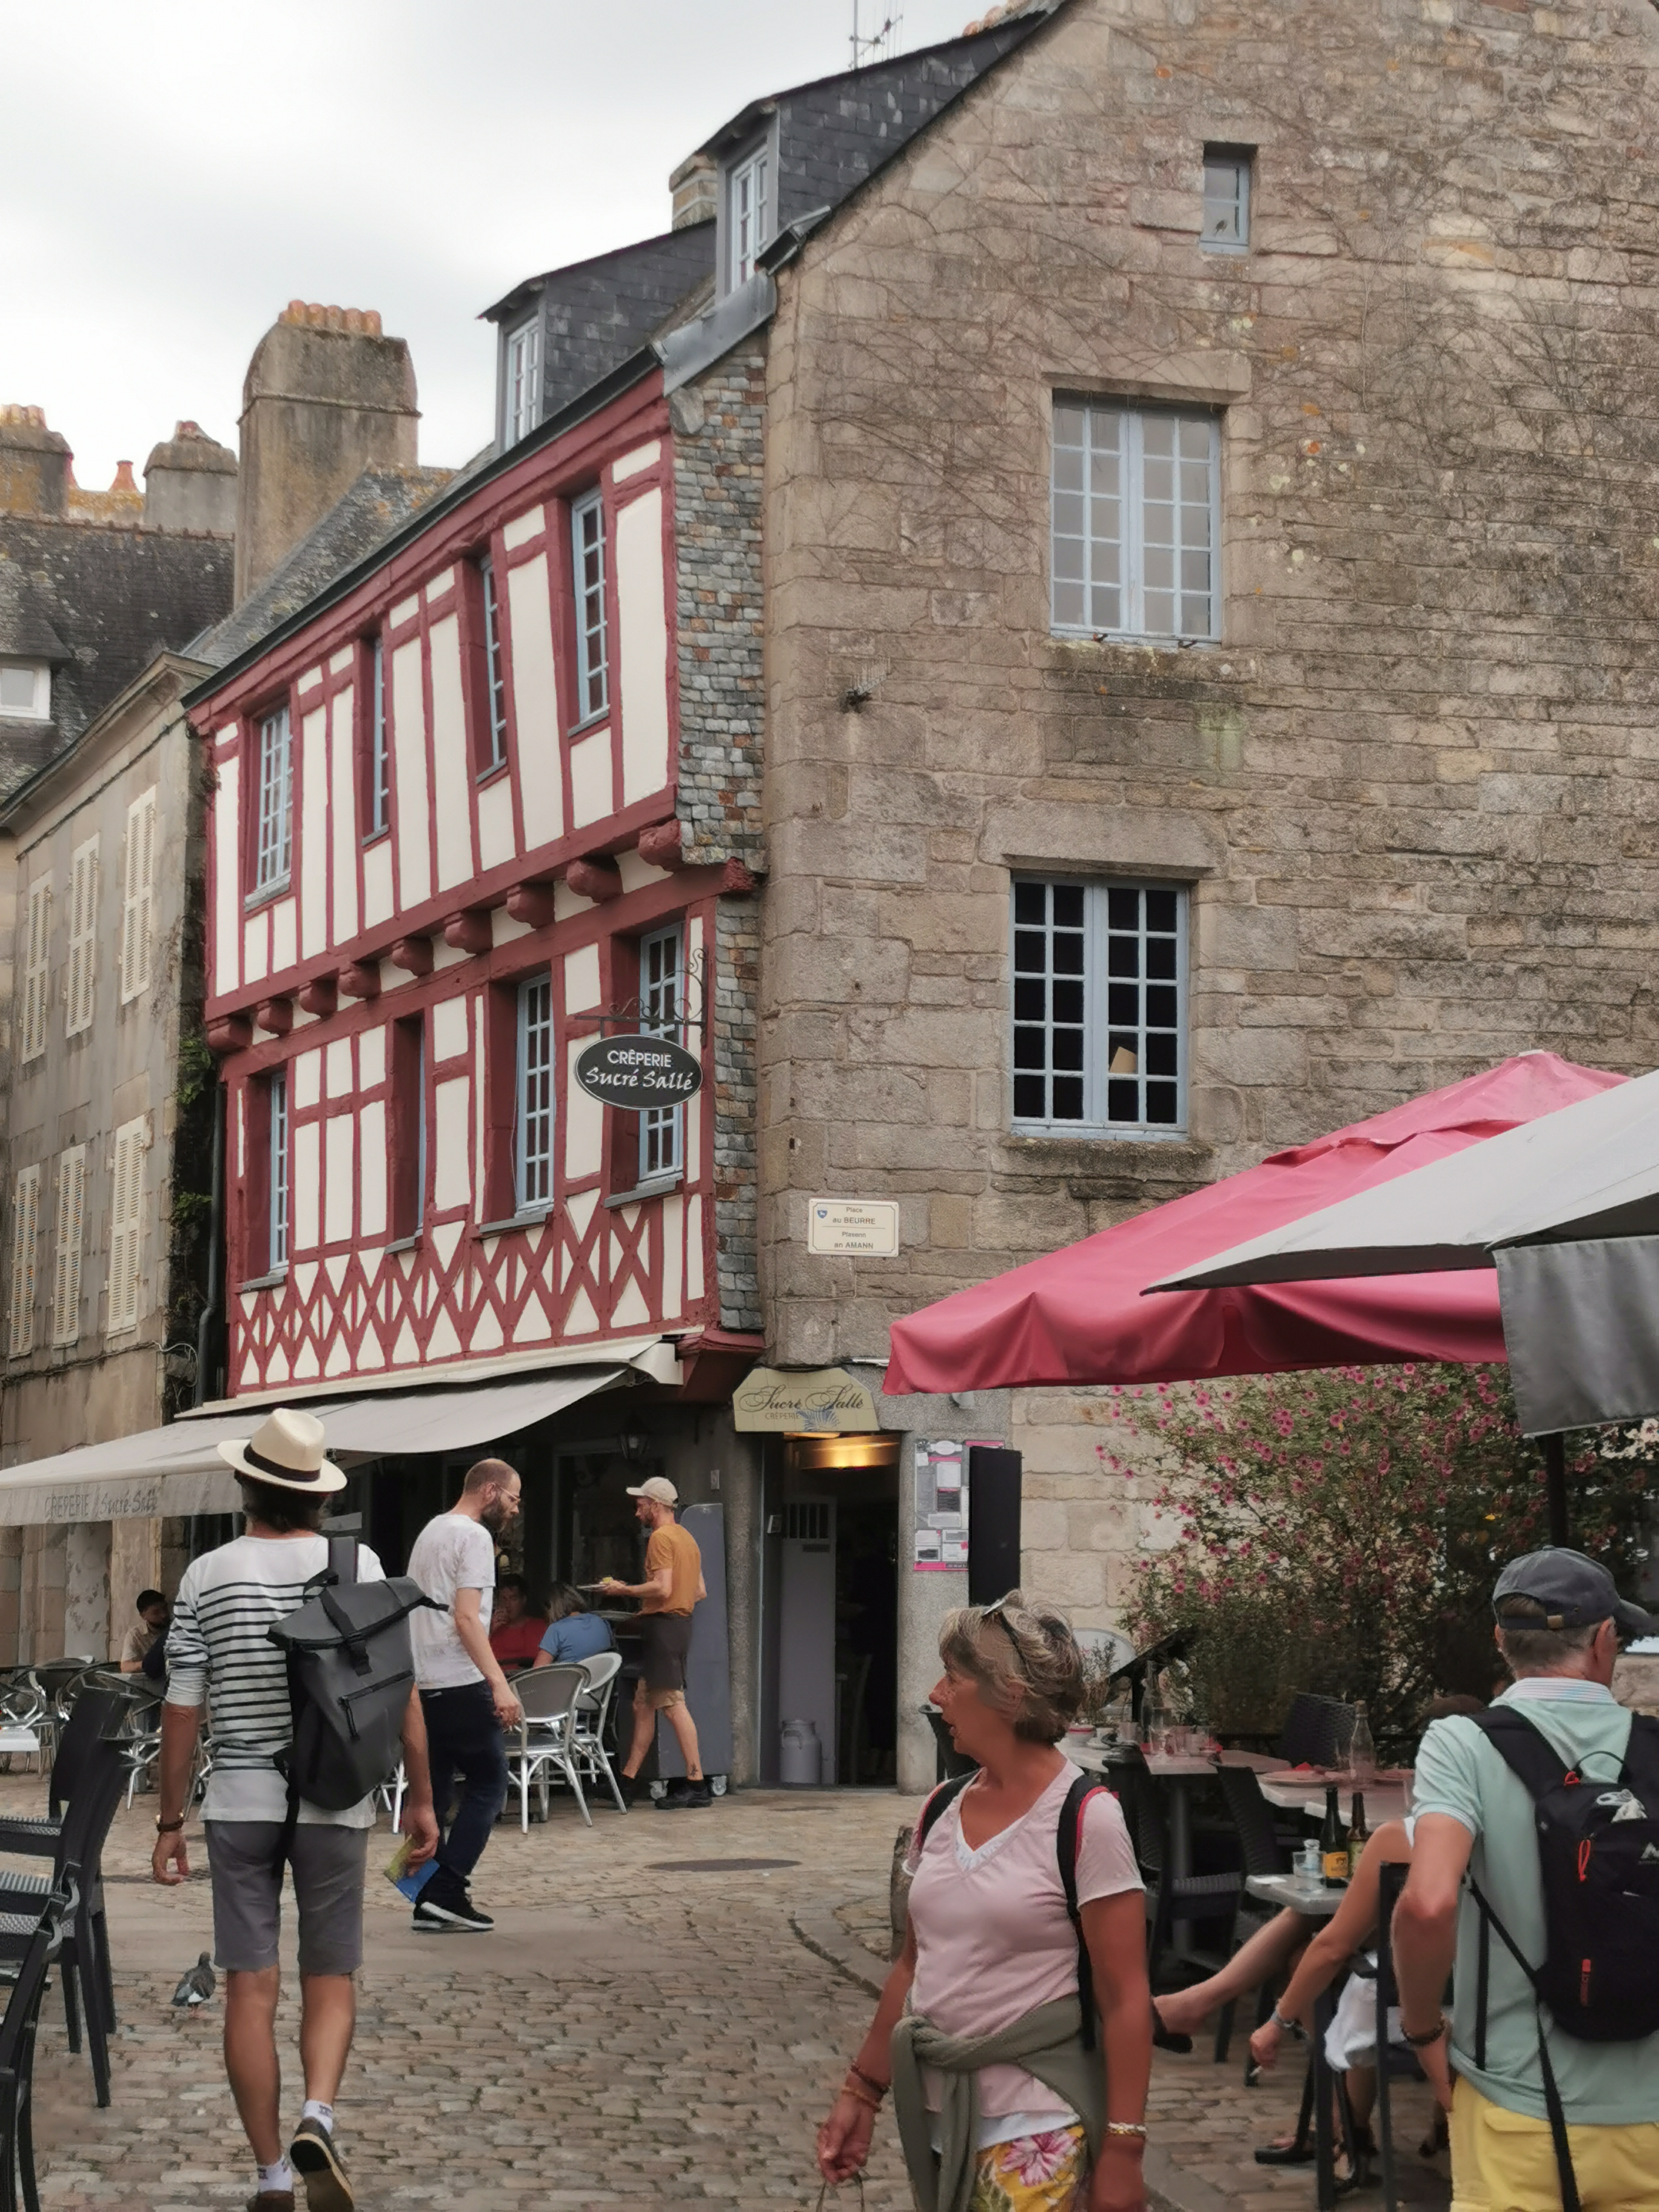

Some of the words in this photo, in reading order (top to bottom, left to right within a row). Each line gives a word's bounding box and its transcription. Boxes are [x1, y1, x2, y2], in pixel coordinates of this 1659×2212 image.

[607, 1050, 672, 1067] CRÊPERIE
[585, 1067, 639, 1087] Sucré
[643, 1071, 693, 1090] Sallé
[843, 1216, 876, 1225] BEURRE
[739, 1384, 802, 1412] Sucré
[805, 1383, 864, 1412] Sallé
